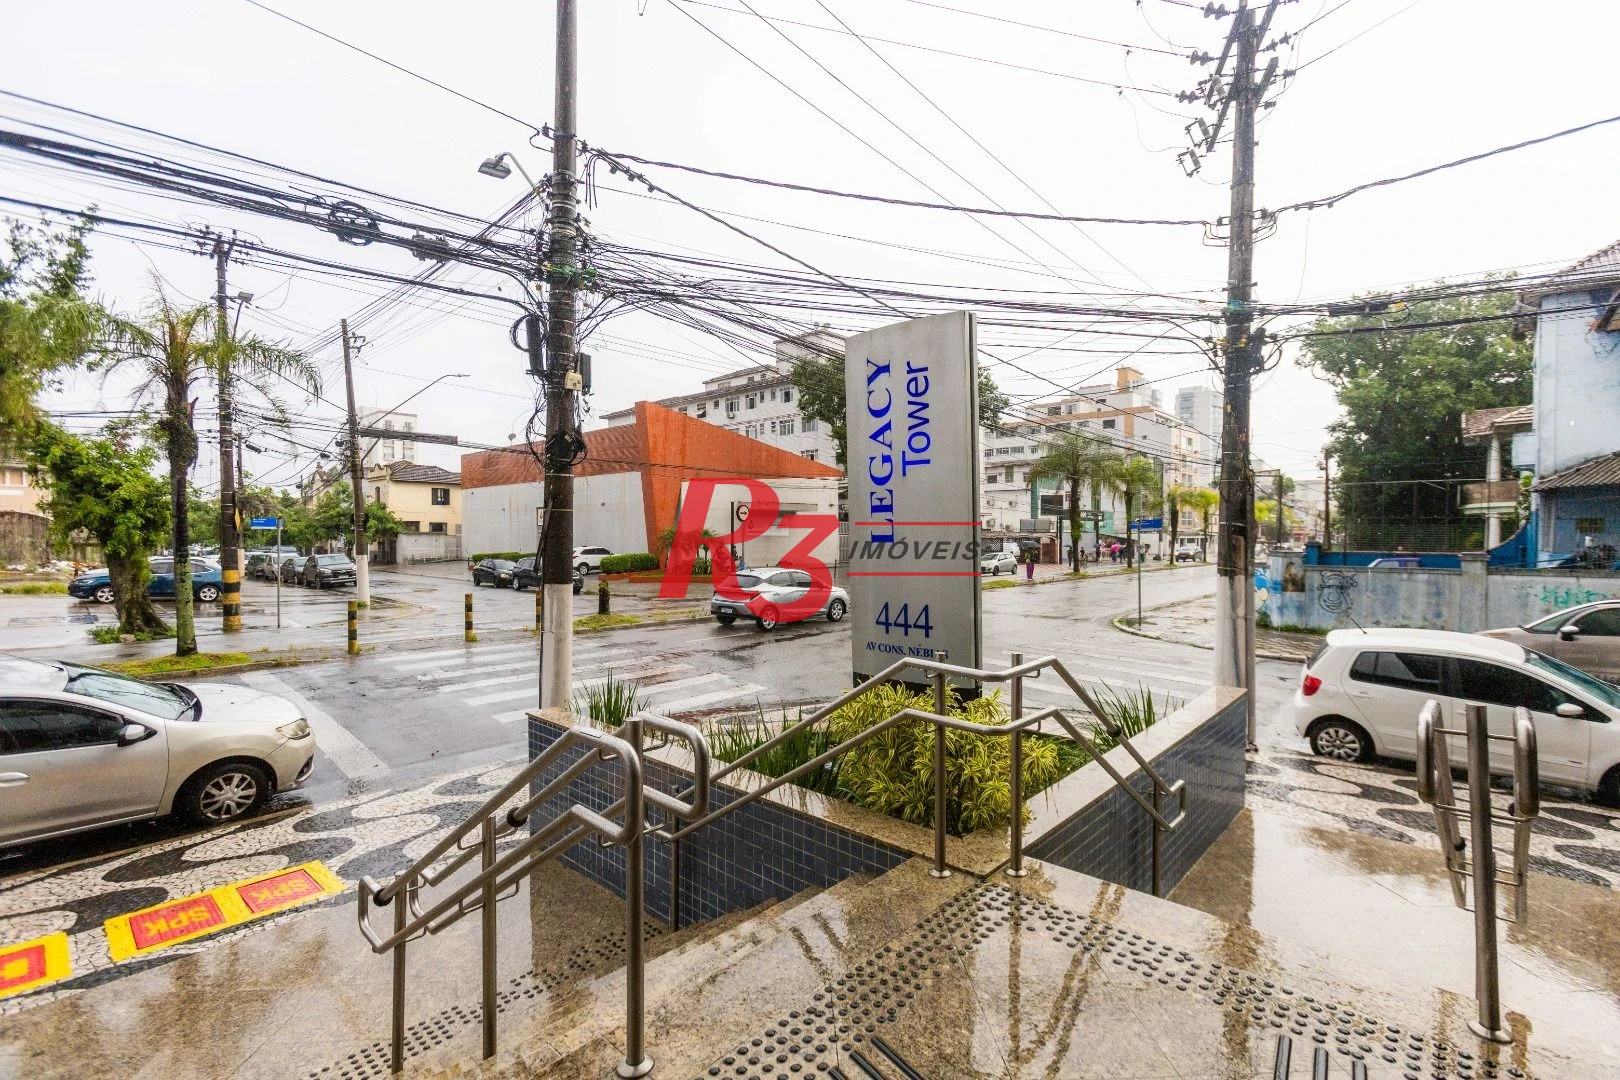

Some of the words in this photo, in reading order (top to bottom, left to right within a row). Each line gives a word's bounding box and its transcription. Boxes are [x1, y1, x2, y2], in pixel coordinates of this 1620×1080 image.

[902, 360, 931, 476] Tower
[866, 357, 895, 545] LEGACY
[875, 601, 933, 638] 444
[865, 641, 876, 651] AV
[877, 643, 906, 656] CONS.
[251, 878, 310, 903] SPK
[143, 905, 211, 937] SPK
